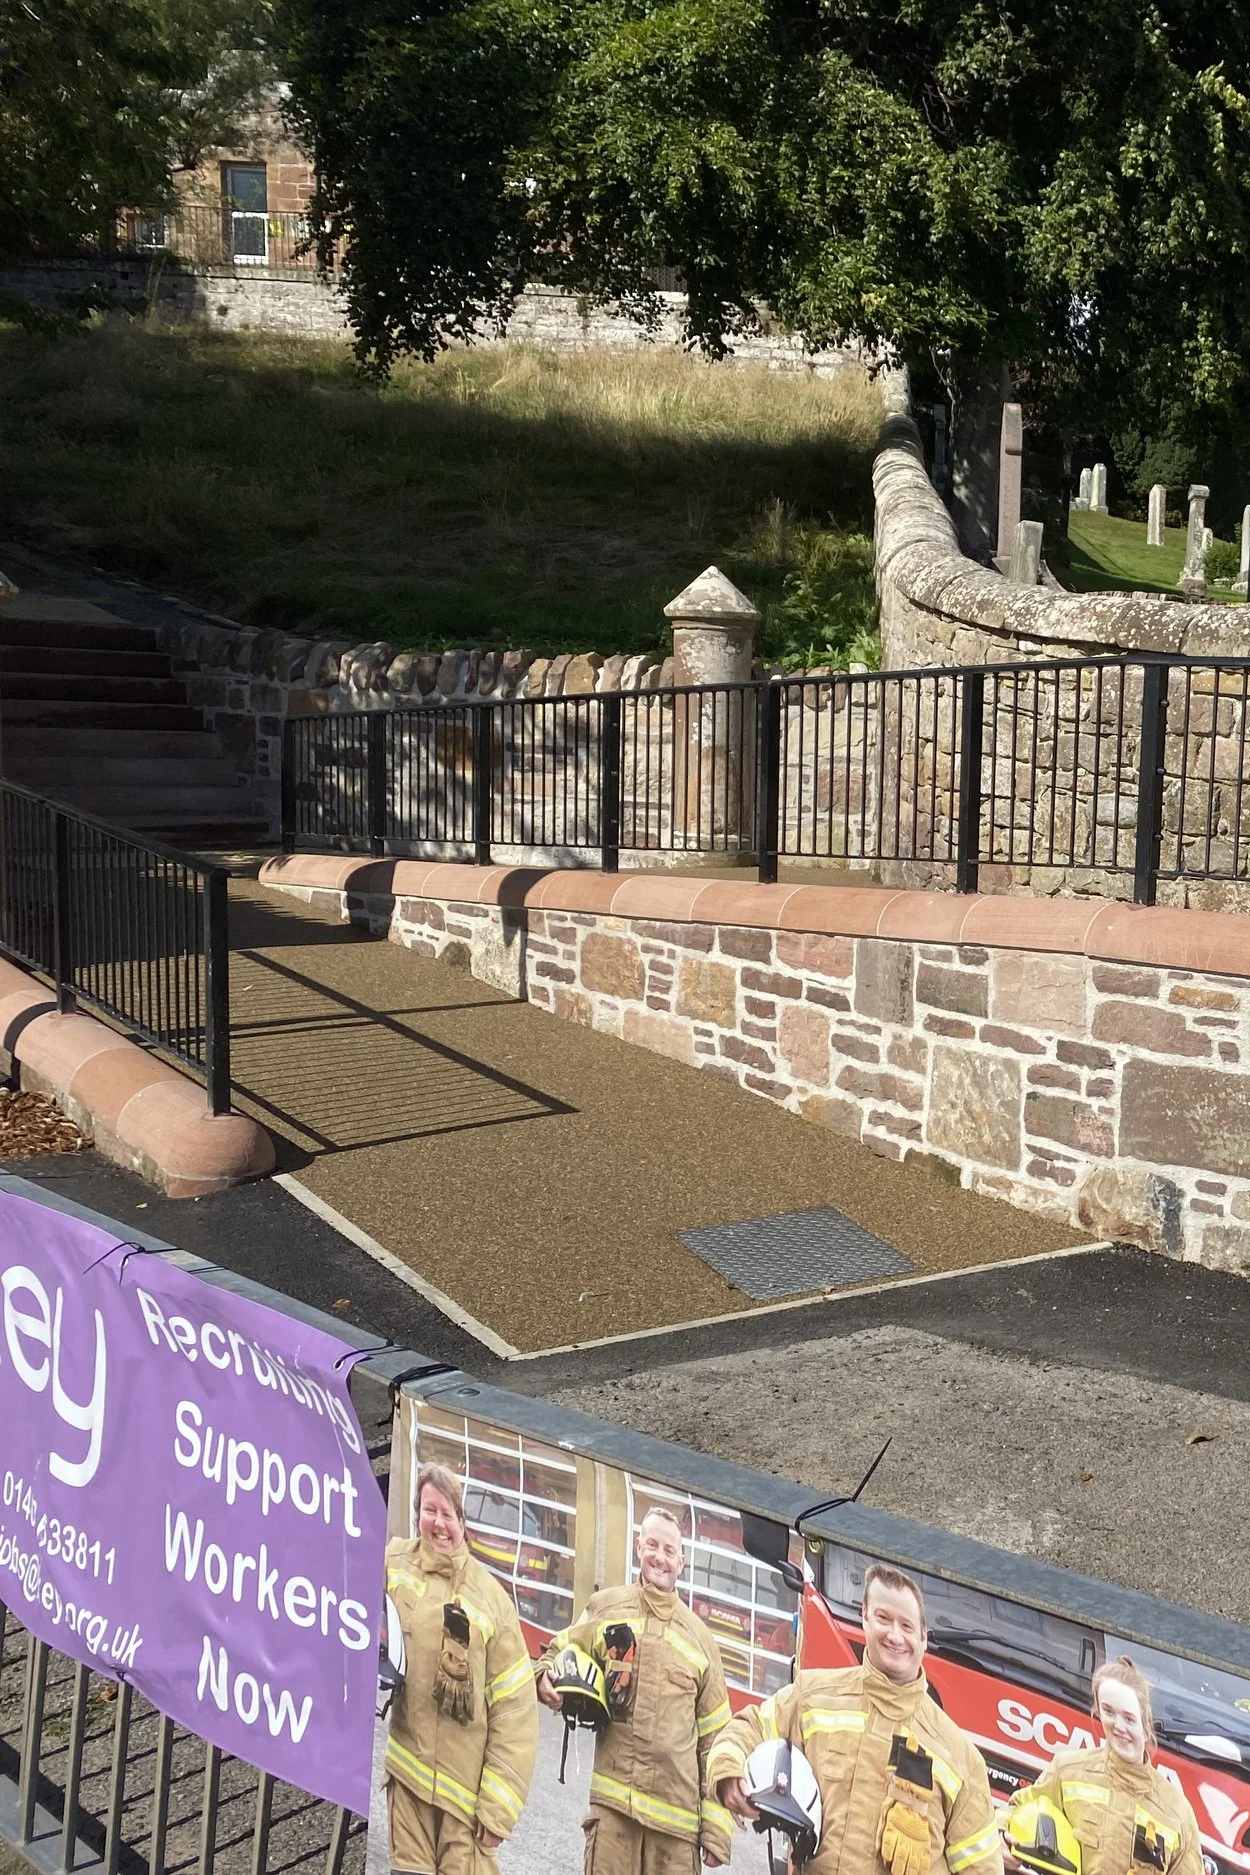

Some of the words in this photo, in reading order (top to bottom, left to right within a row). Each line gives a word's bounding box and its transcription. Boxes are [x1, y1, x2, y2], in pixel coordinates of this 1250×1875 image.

[174, 1400, 362, 1538] Support
[165, 1503, 371, 1651] Workers
[197, 1635, 313, 1744] Now
